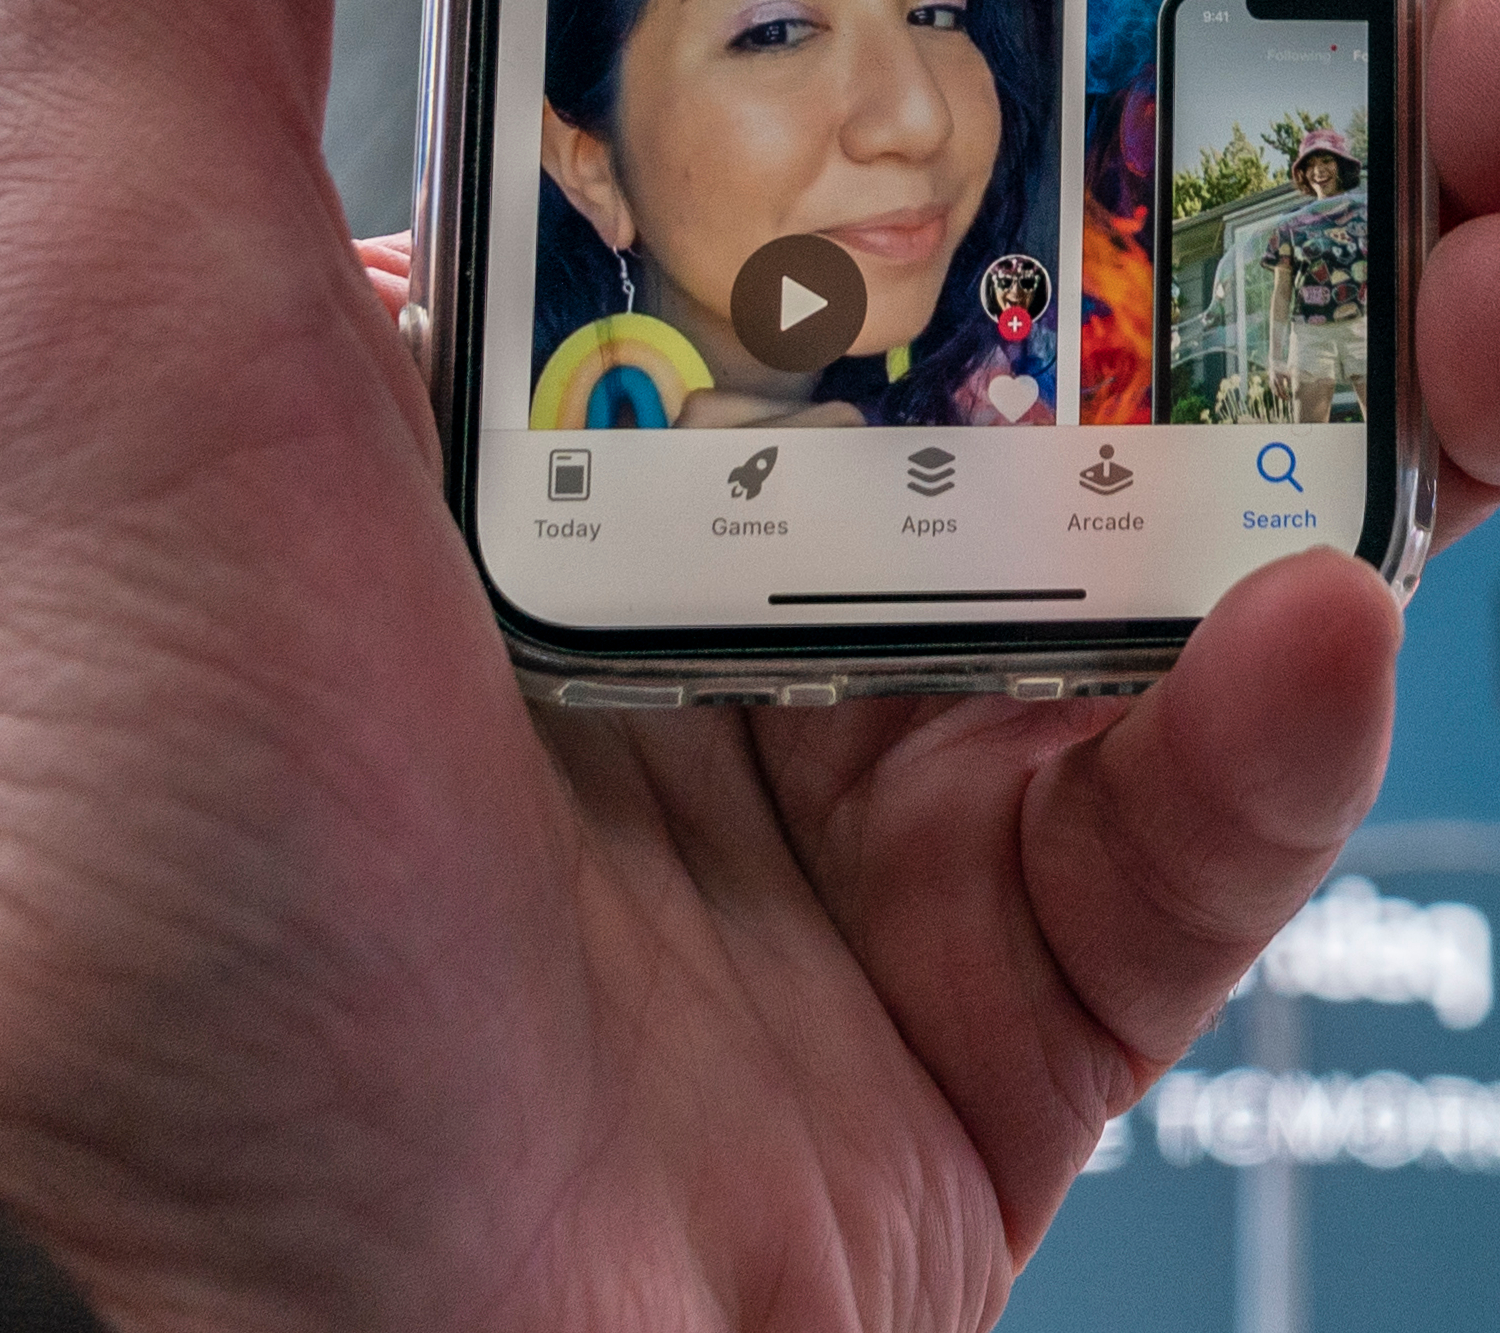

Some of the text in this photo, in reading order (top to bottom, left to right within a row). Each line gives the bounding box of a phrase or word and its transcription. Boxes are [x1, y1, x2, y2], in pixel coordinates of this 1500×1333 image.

[1202, 10, 1230, 23] 9:41
[1266, 49, 1333, 65] Following
[534, 519, 602, 541] Today
[711, 517, 789, 537] Games
[902, 515, 958, 537] Apps
[1067, 512, 1145, 532] Arcade
[1242, 510, 1317, 530] Search
